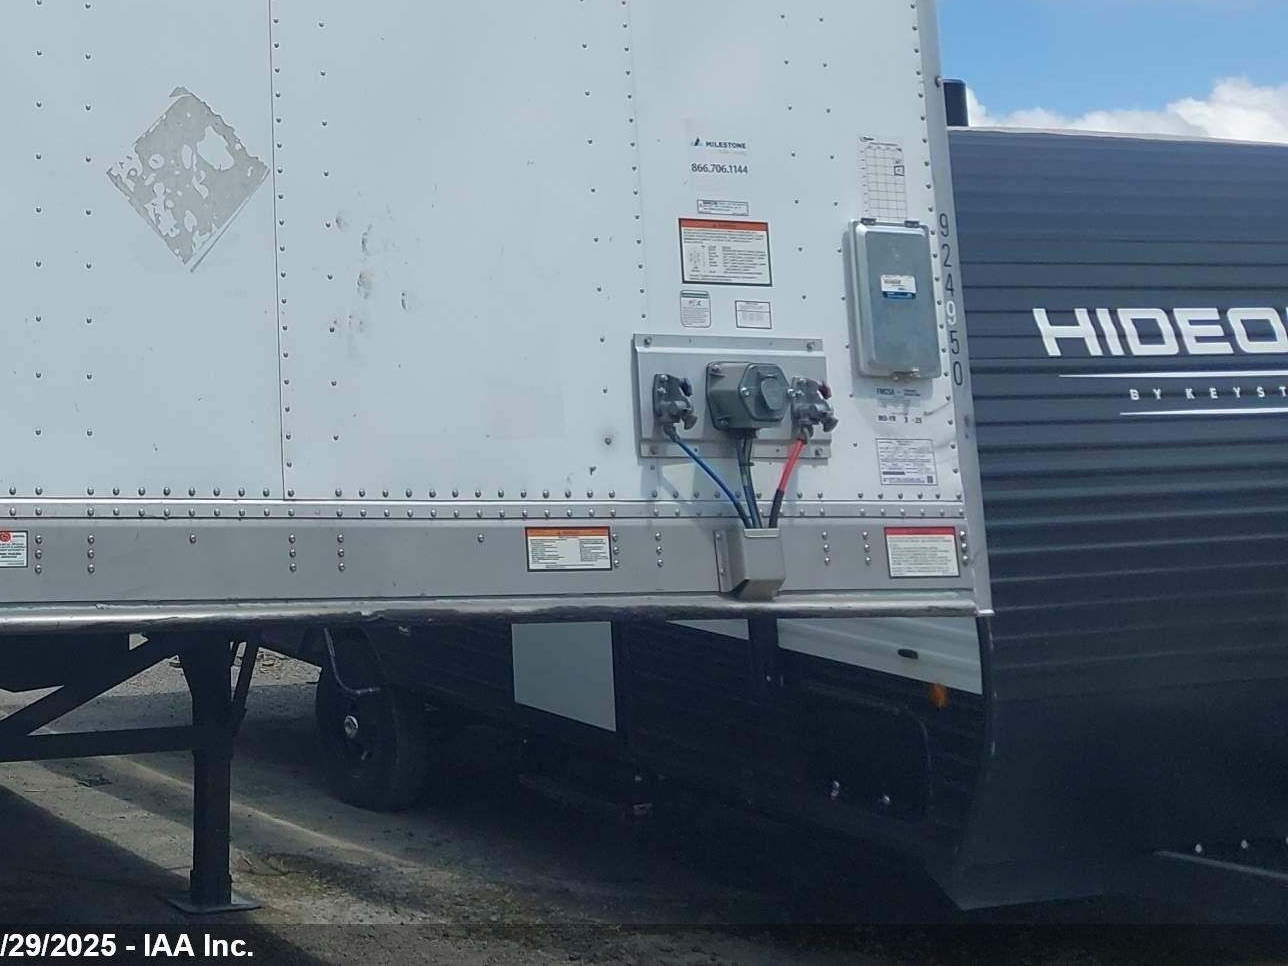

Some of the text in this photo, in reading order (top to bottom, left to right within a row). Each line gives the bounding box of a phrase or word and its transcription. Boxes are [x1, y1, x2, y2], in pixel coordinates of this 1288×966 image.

[705, 141, 746, 149] MILESTONE
[691, 163, 748, 174] 866.706.1144
[1032, 308, 1288, 356] HIDEO
[1129, 388, 1162, 401] BY
